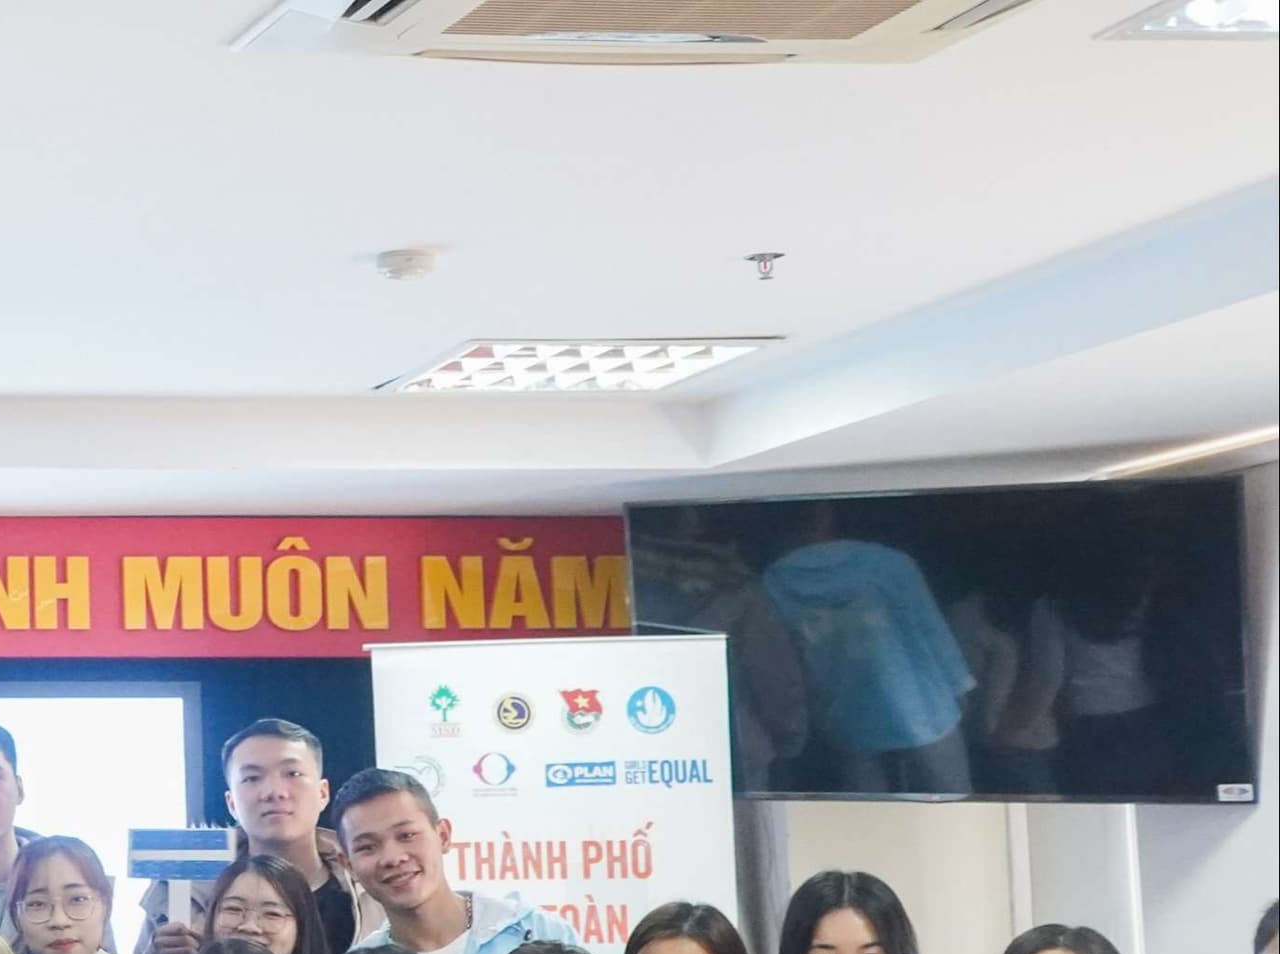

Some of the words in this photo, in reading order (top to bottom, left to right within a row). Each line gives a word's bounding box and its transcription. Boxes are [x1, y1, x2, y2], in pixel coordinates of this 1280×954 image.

[121, 535, 389, 631] MUÔN
[420, 537, 631, 630] NĂM
[574, 764, 615, 779] PLAN
[624, 770, 646, 785] GET
[648, 759, 713, 789] EQUAL
[453, 830, 568, 881] THÀNH
[581, 820, 655, 881] PHỐ
